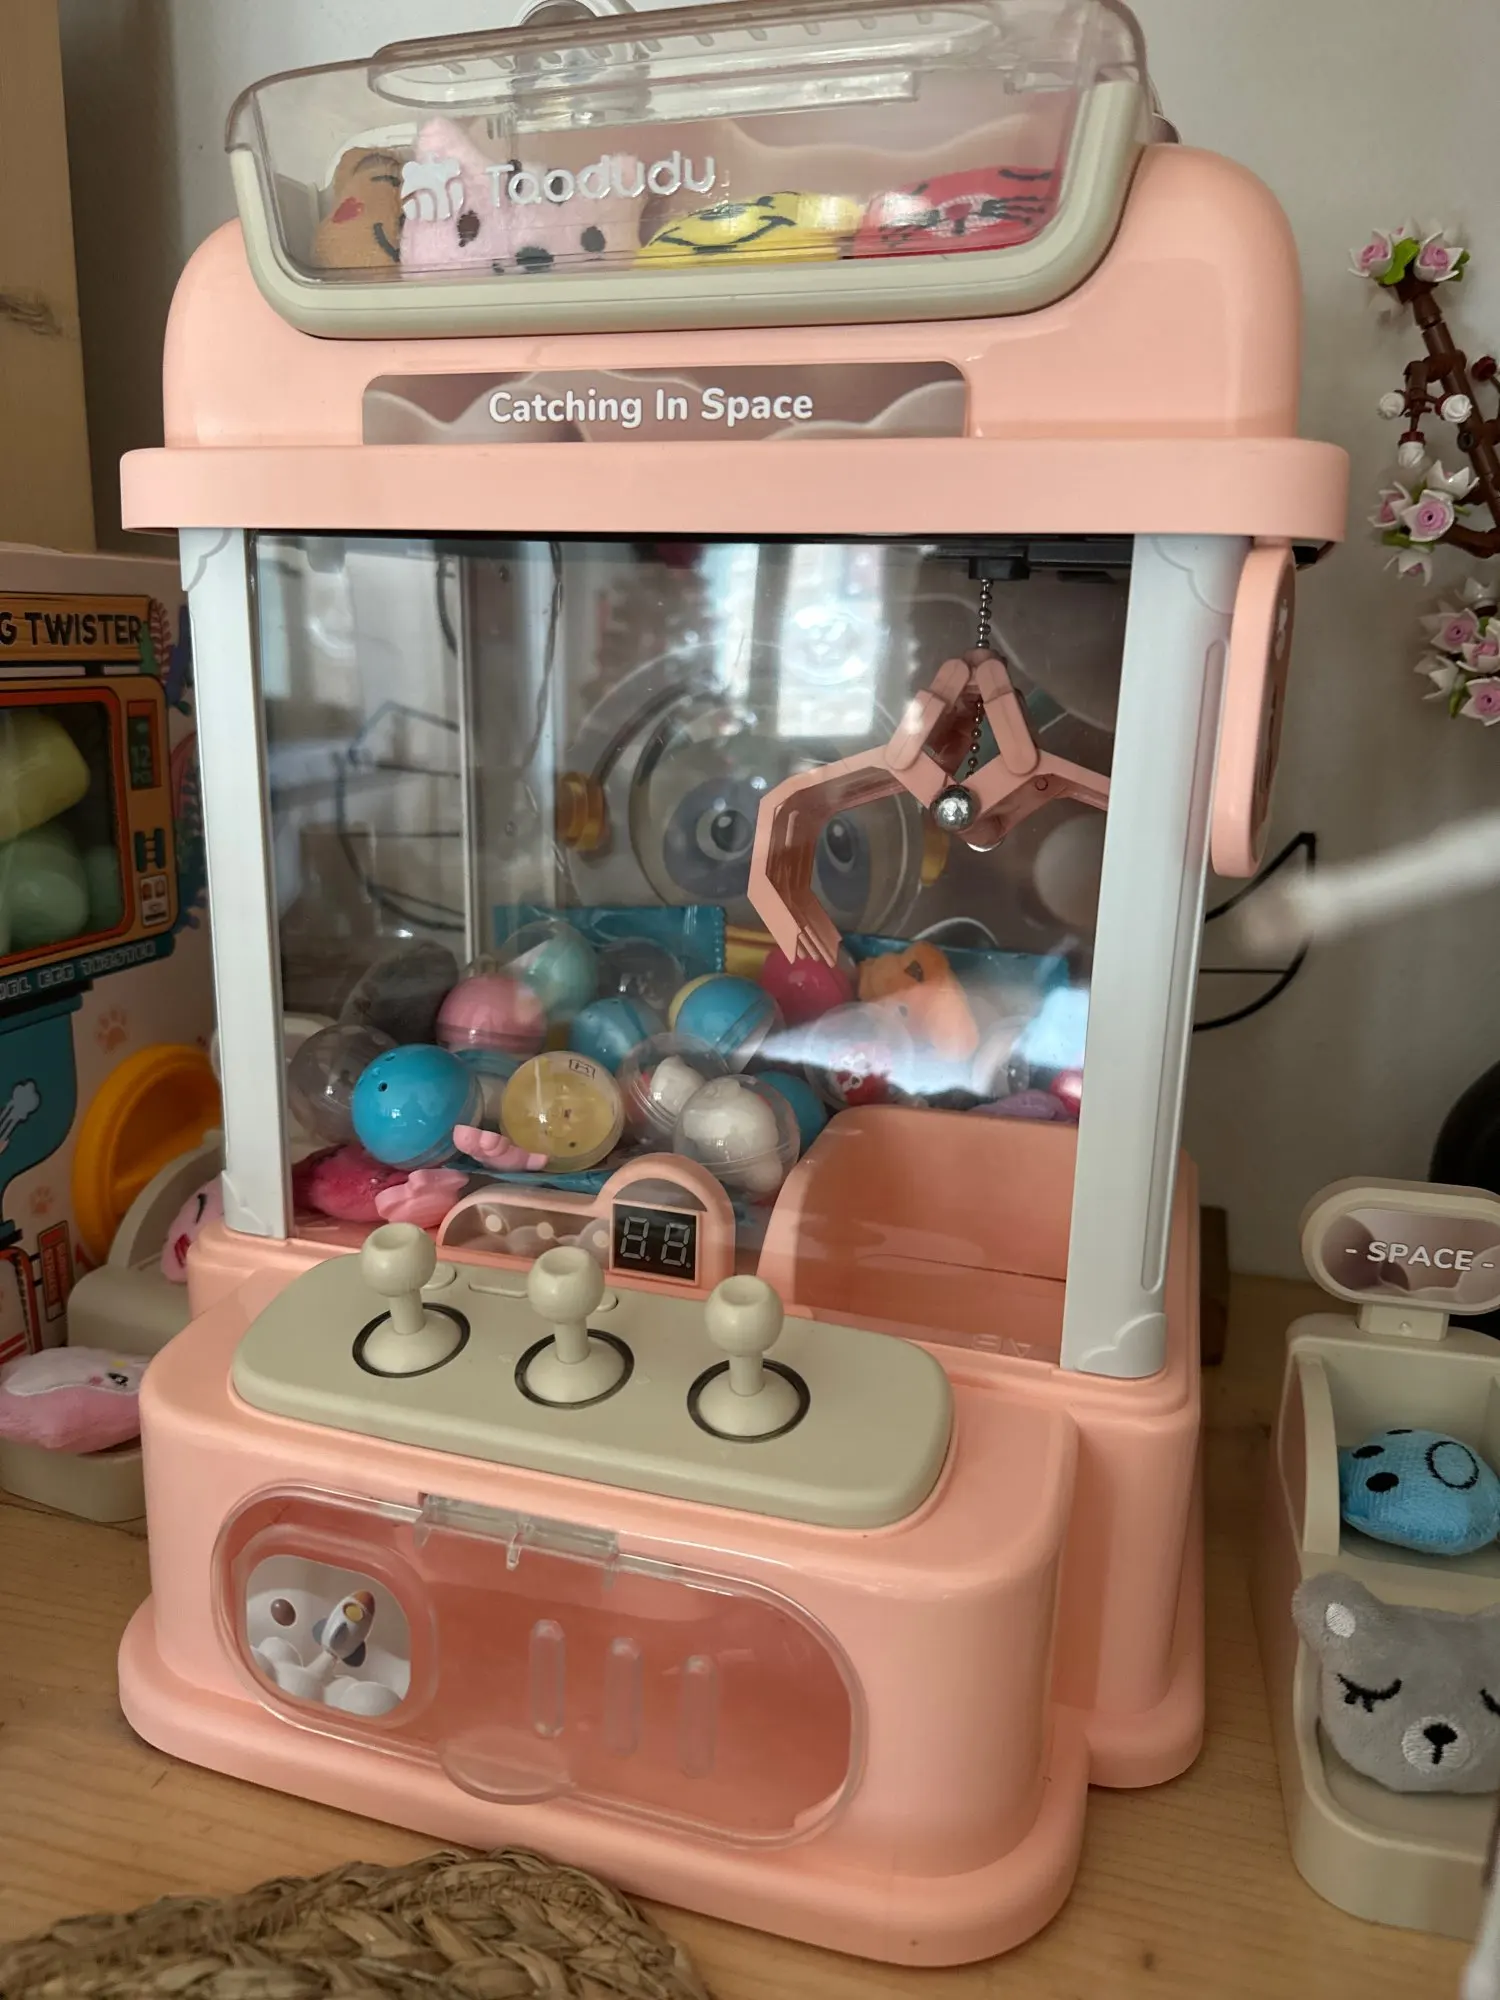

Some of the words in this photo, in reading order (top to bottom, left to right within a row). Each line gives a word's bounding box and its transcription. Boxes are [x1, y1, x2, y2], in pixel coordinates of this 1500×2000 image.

[485, 151, 717, 208] Taodudu
[488, 388, 643, 429] Catching
[655, 388, 689, 421] In
[700, 387, 814, 427] Space
[24, 611, 142, 646] TWISTER
[1367, 1241, 1474, 1270] SPACE
